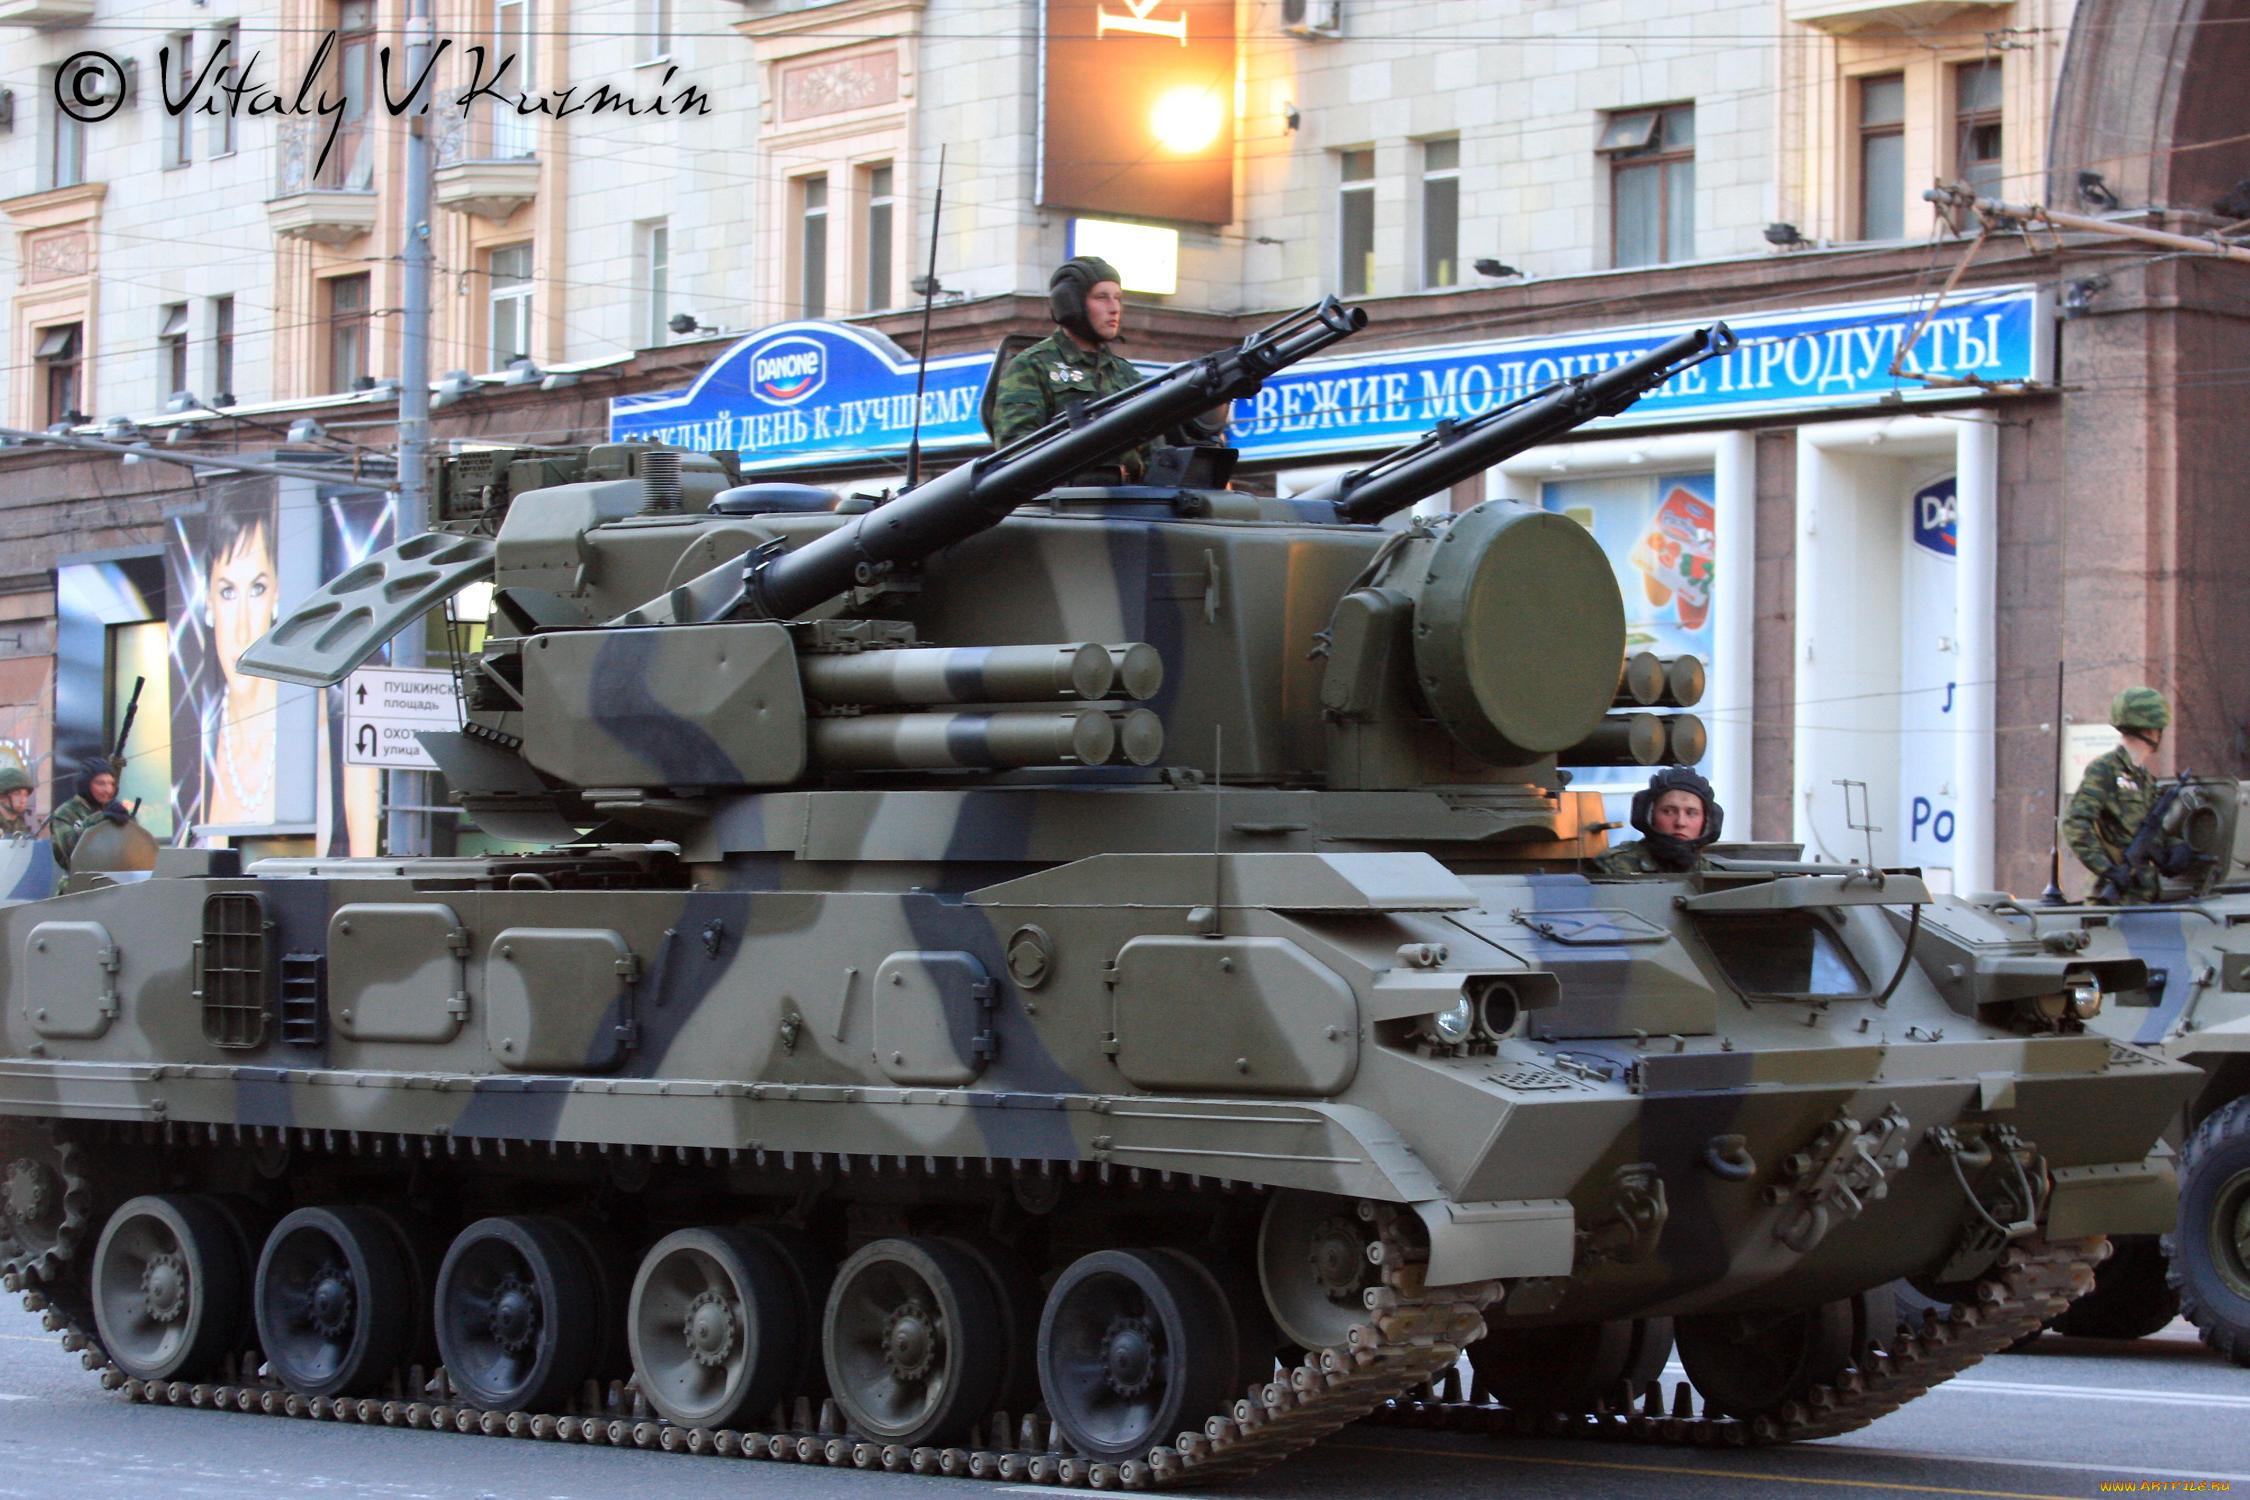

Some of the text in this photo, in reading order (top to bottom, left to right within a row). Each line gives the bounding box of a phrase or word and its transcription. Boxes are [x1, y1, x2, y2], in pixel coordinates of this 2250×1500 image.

[1228, 314, 2003, 438] СВЕЖИЕ МОЛОЕ ПРОДУКТЫ
[622, 385, 979, 452] ДЫЙ ДЕНЬ К ЛУЧШЕМУ
[384, 681, 460, 696] ПУШКИНСК
[384, 699, 440, 711] площадь
[383, 745, 421, 756] улица
